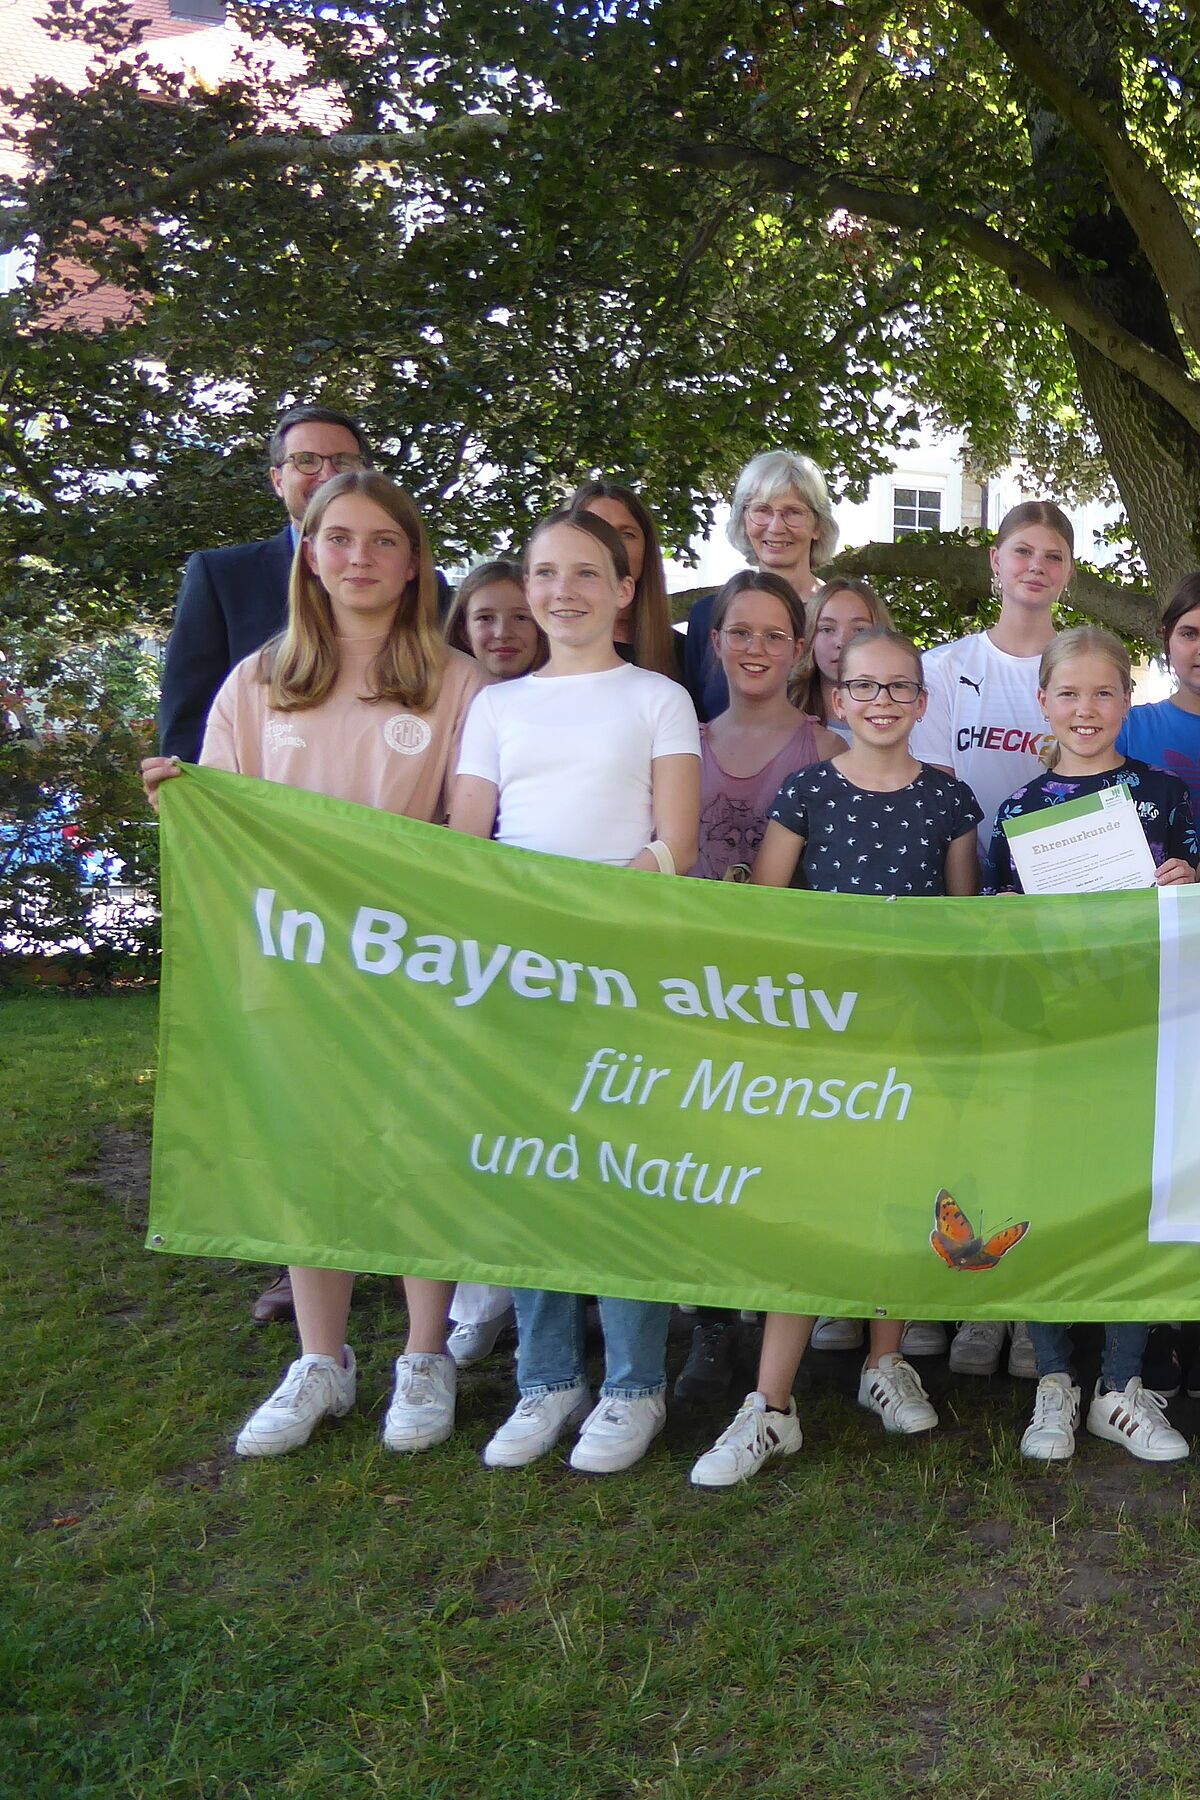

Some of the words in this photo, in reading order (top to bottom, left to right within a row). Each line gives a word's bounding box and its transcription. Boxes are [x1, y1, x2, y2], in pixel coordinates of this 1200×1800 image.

[1031, 820, 1121, 855] Ehrenurkunde
[253, 886, 327, 967] In
[351, 906, 638, 1010] Bayern
[658, 964, 859, 1033] aktiv
[568, 1046, 672, 1114] für
[679, 1057, 914, 1123] Mensch
[467, 1132, 581, 1182] und
[597, 1140, 763, 1207] Natur
